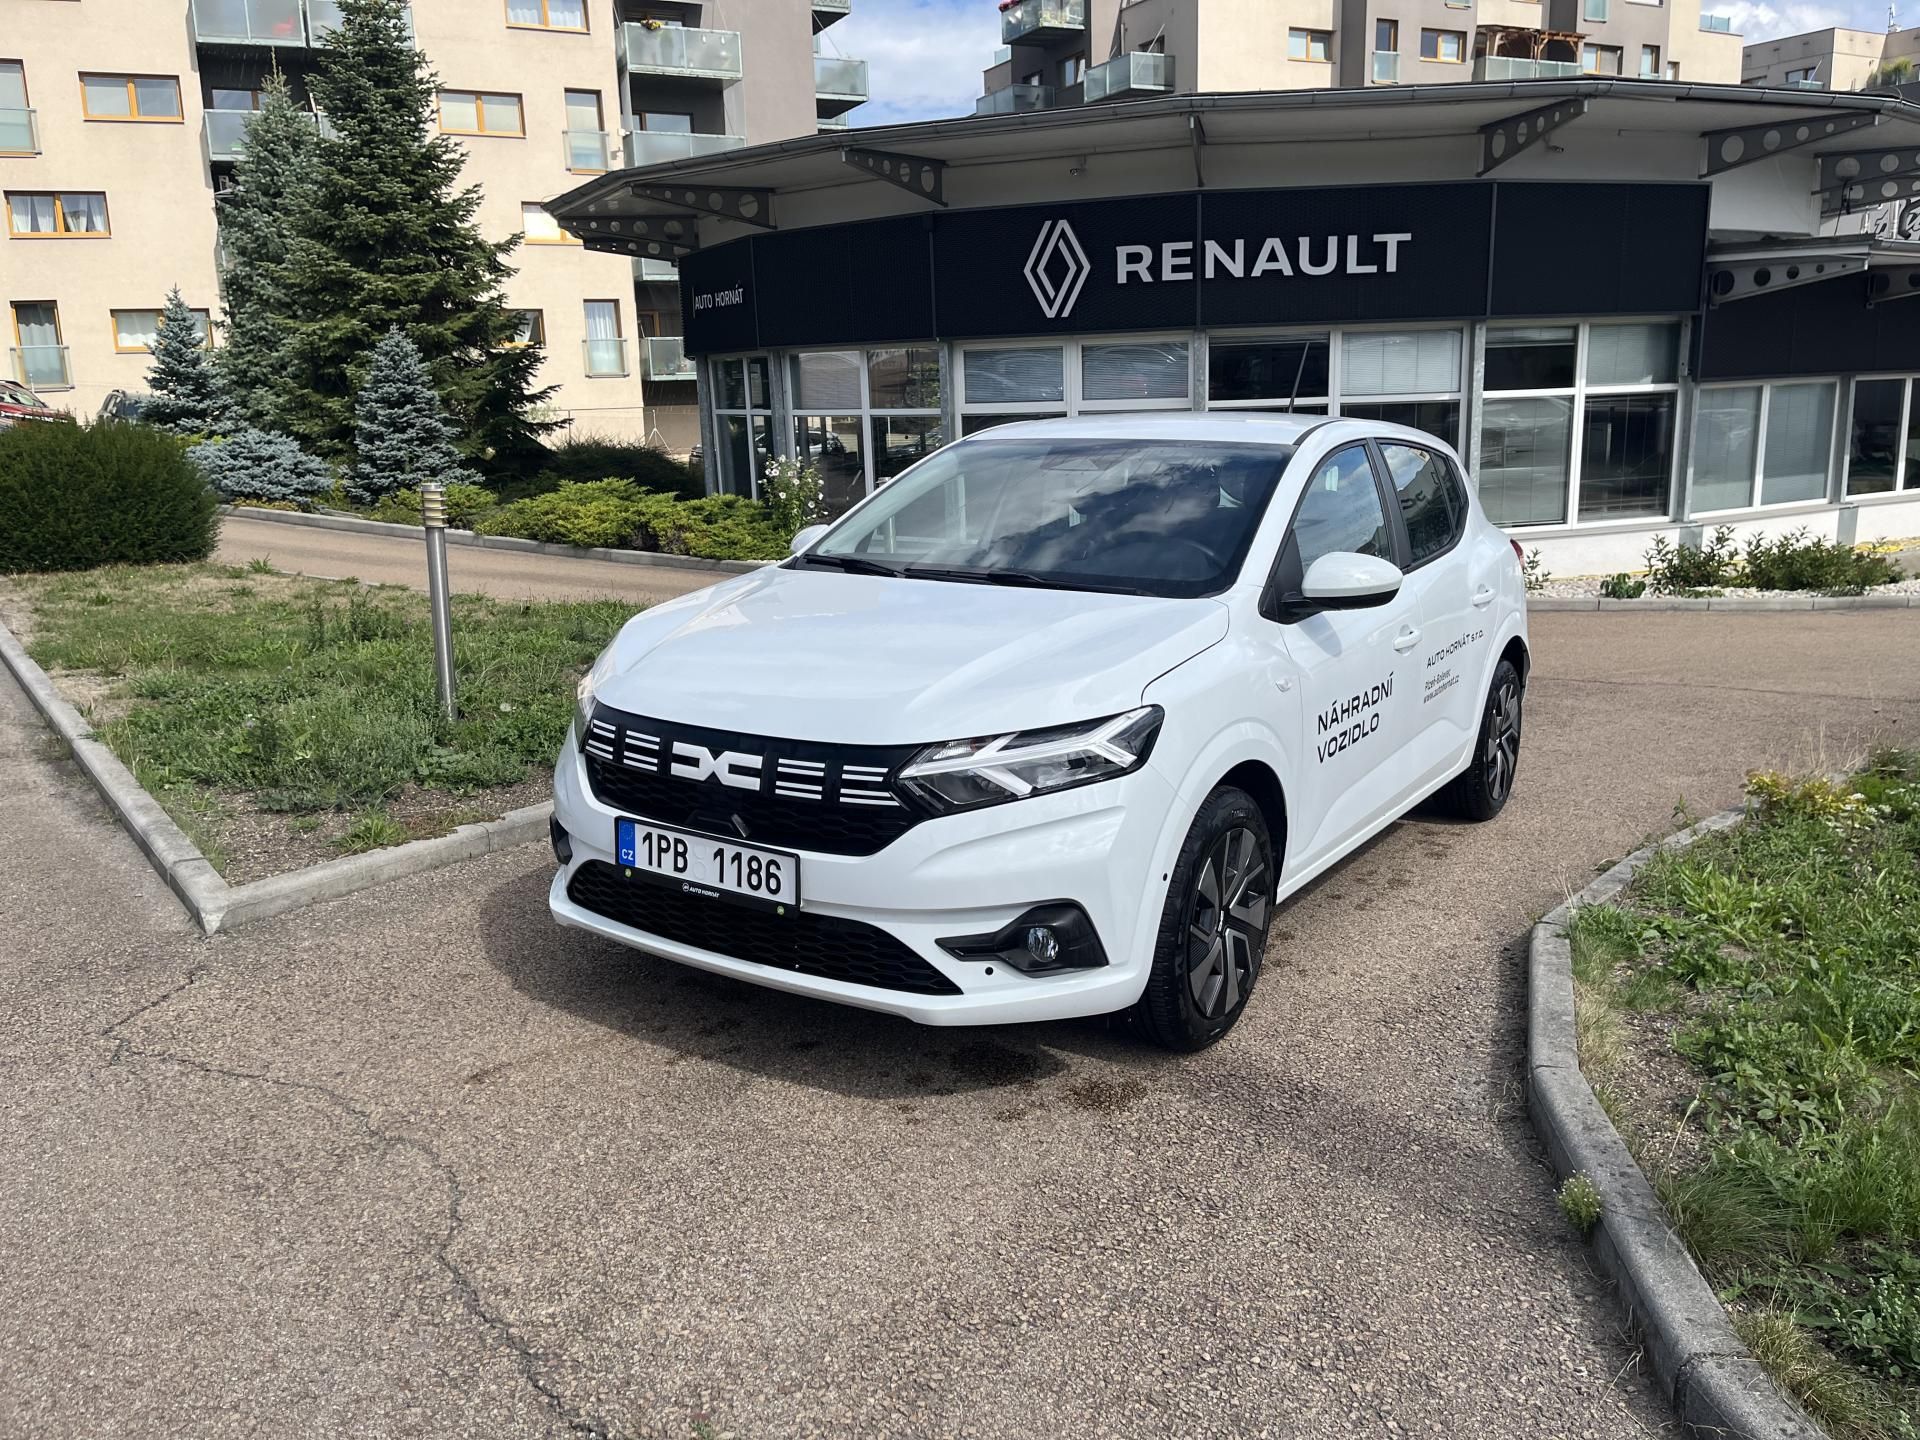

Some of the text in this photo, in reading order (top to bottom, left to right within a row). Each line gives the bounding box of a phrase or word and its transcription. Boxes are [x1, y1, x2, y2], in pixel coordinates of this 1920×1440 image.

[1116, 233, 1412, 284] RENAULT
[695, 283, 744, 310] AUTO HORNÁT
[1427, 649, 1445, 669] AUTO
[1446, 633, 1470, 656] HORNÁT
[1317, 671, 1394, 735] NÁHRADNÍ
[1317, 712, 1380, 764] VOZIDLO
[621, 849, 634, 861] CZ
[642, 831, 782, 895] 1PB 1186
[689, 886, 702, 894] AUTO
